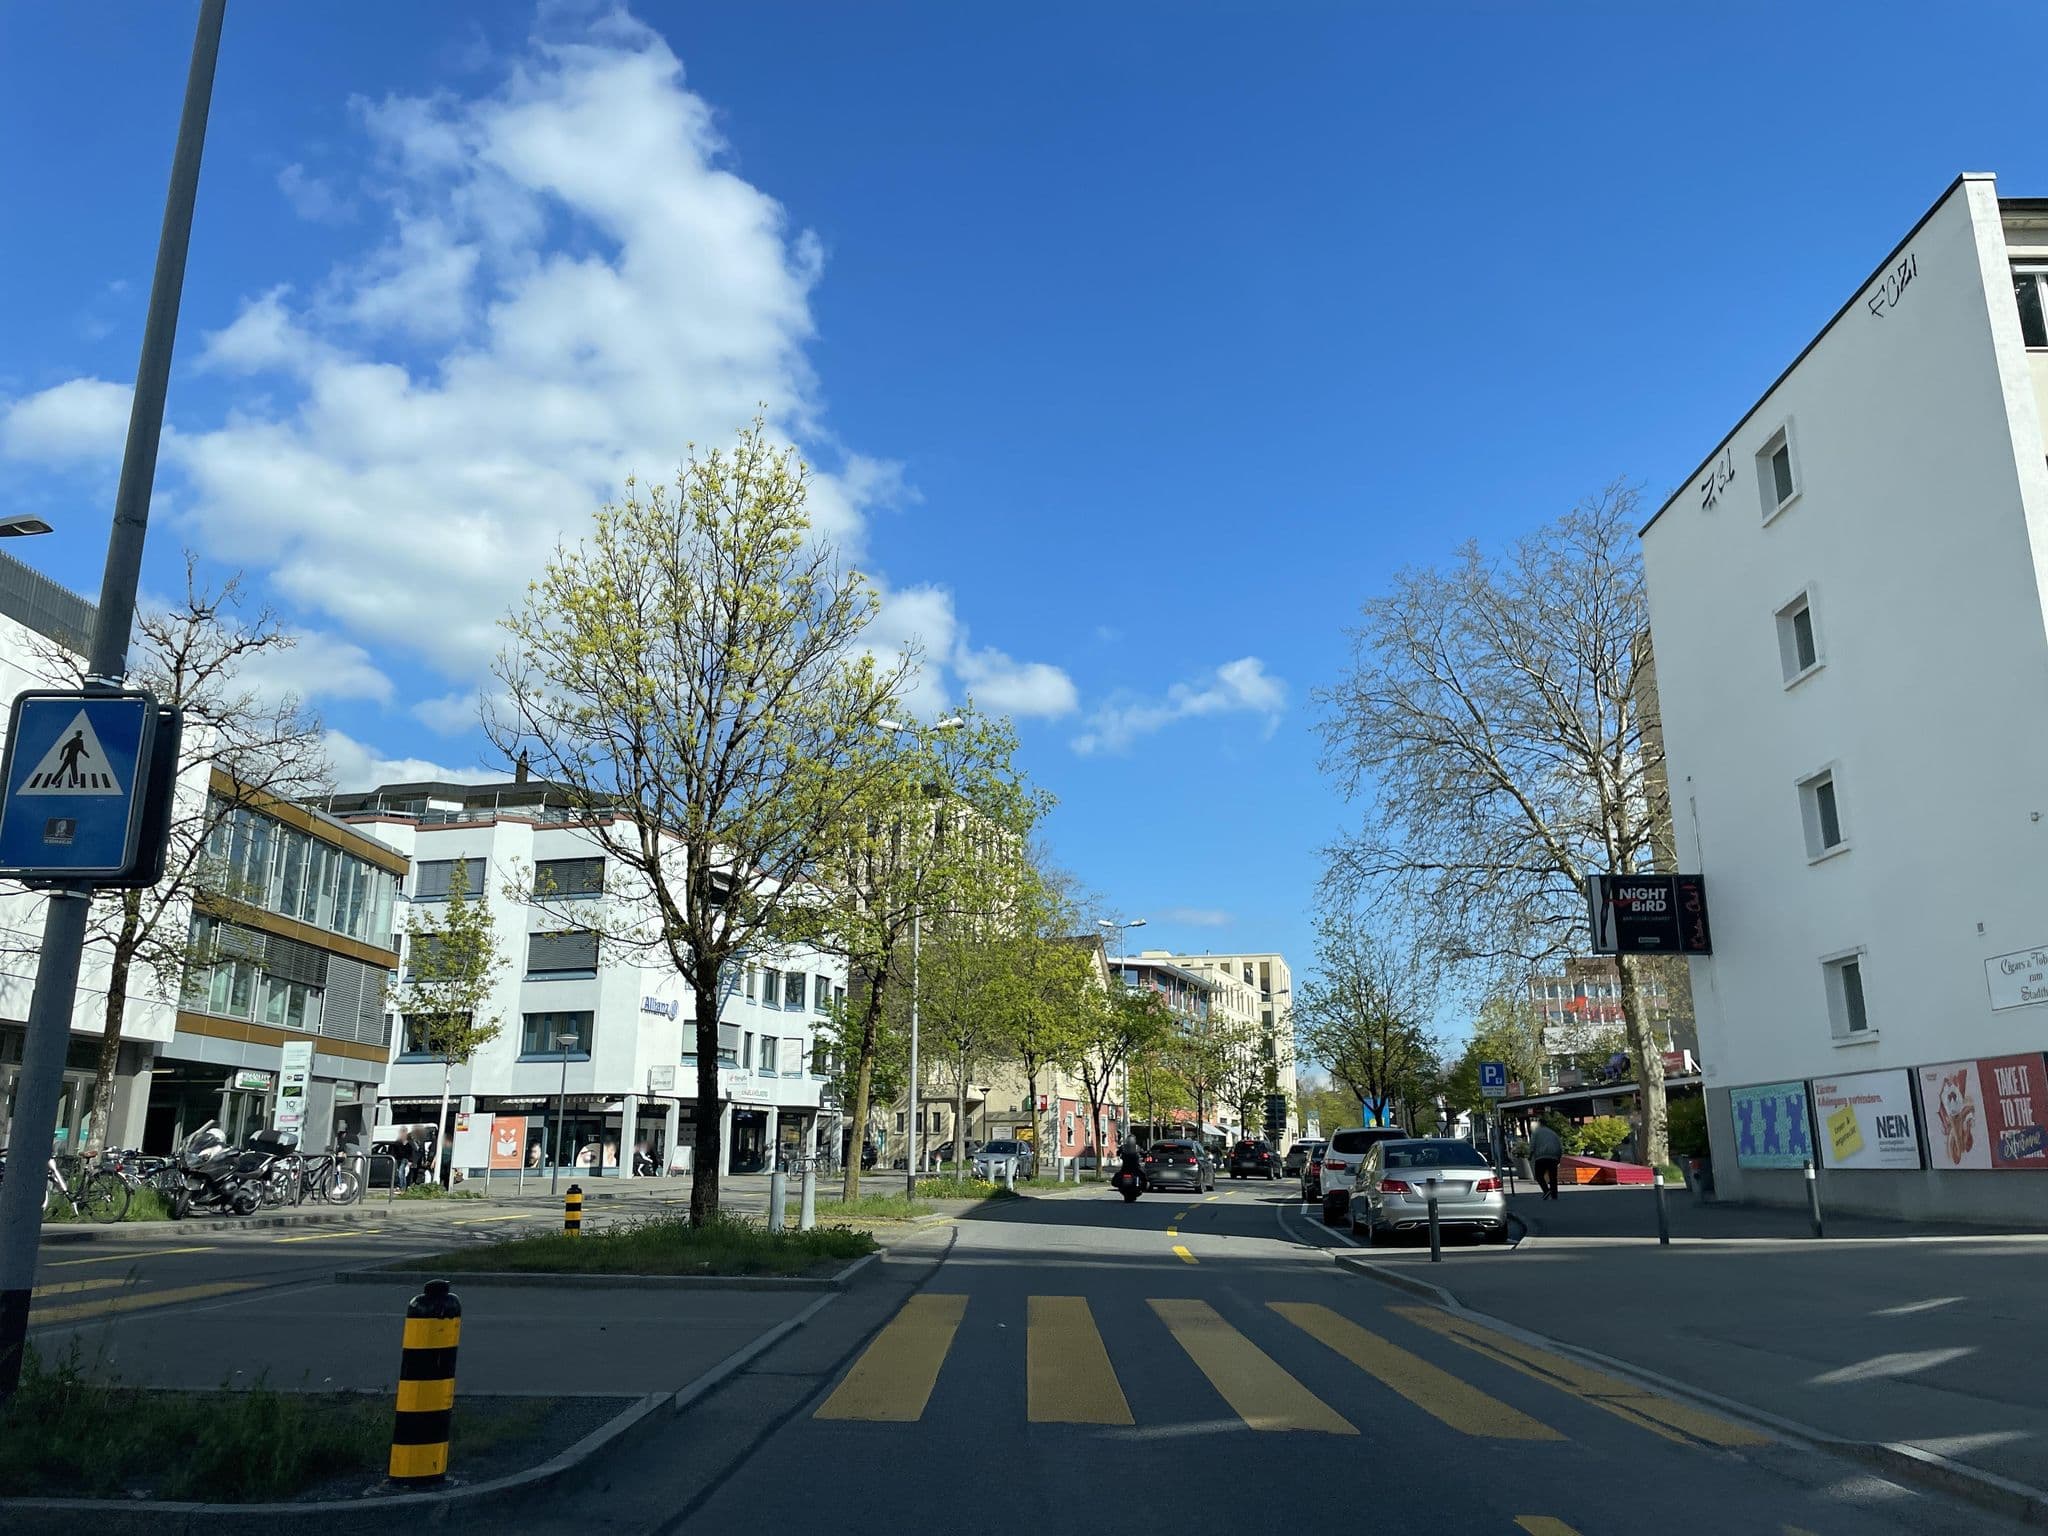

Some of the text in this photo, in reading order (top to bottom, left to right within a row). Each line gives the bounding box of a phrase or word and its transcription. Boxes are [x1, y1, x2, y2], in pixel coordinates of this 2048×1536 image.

[1619, 888, 1667, 900] NiGHT
[644, 996, 669, 1013] Allianz
[1485, 1066, 1496, 1083] P
[1994, 1065, 2030, 1095] TAKE IT
[2000, 1097, 2035, 1127] TO THE
[1876, 1114, 1910, 1139] NEIN
